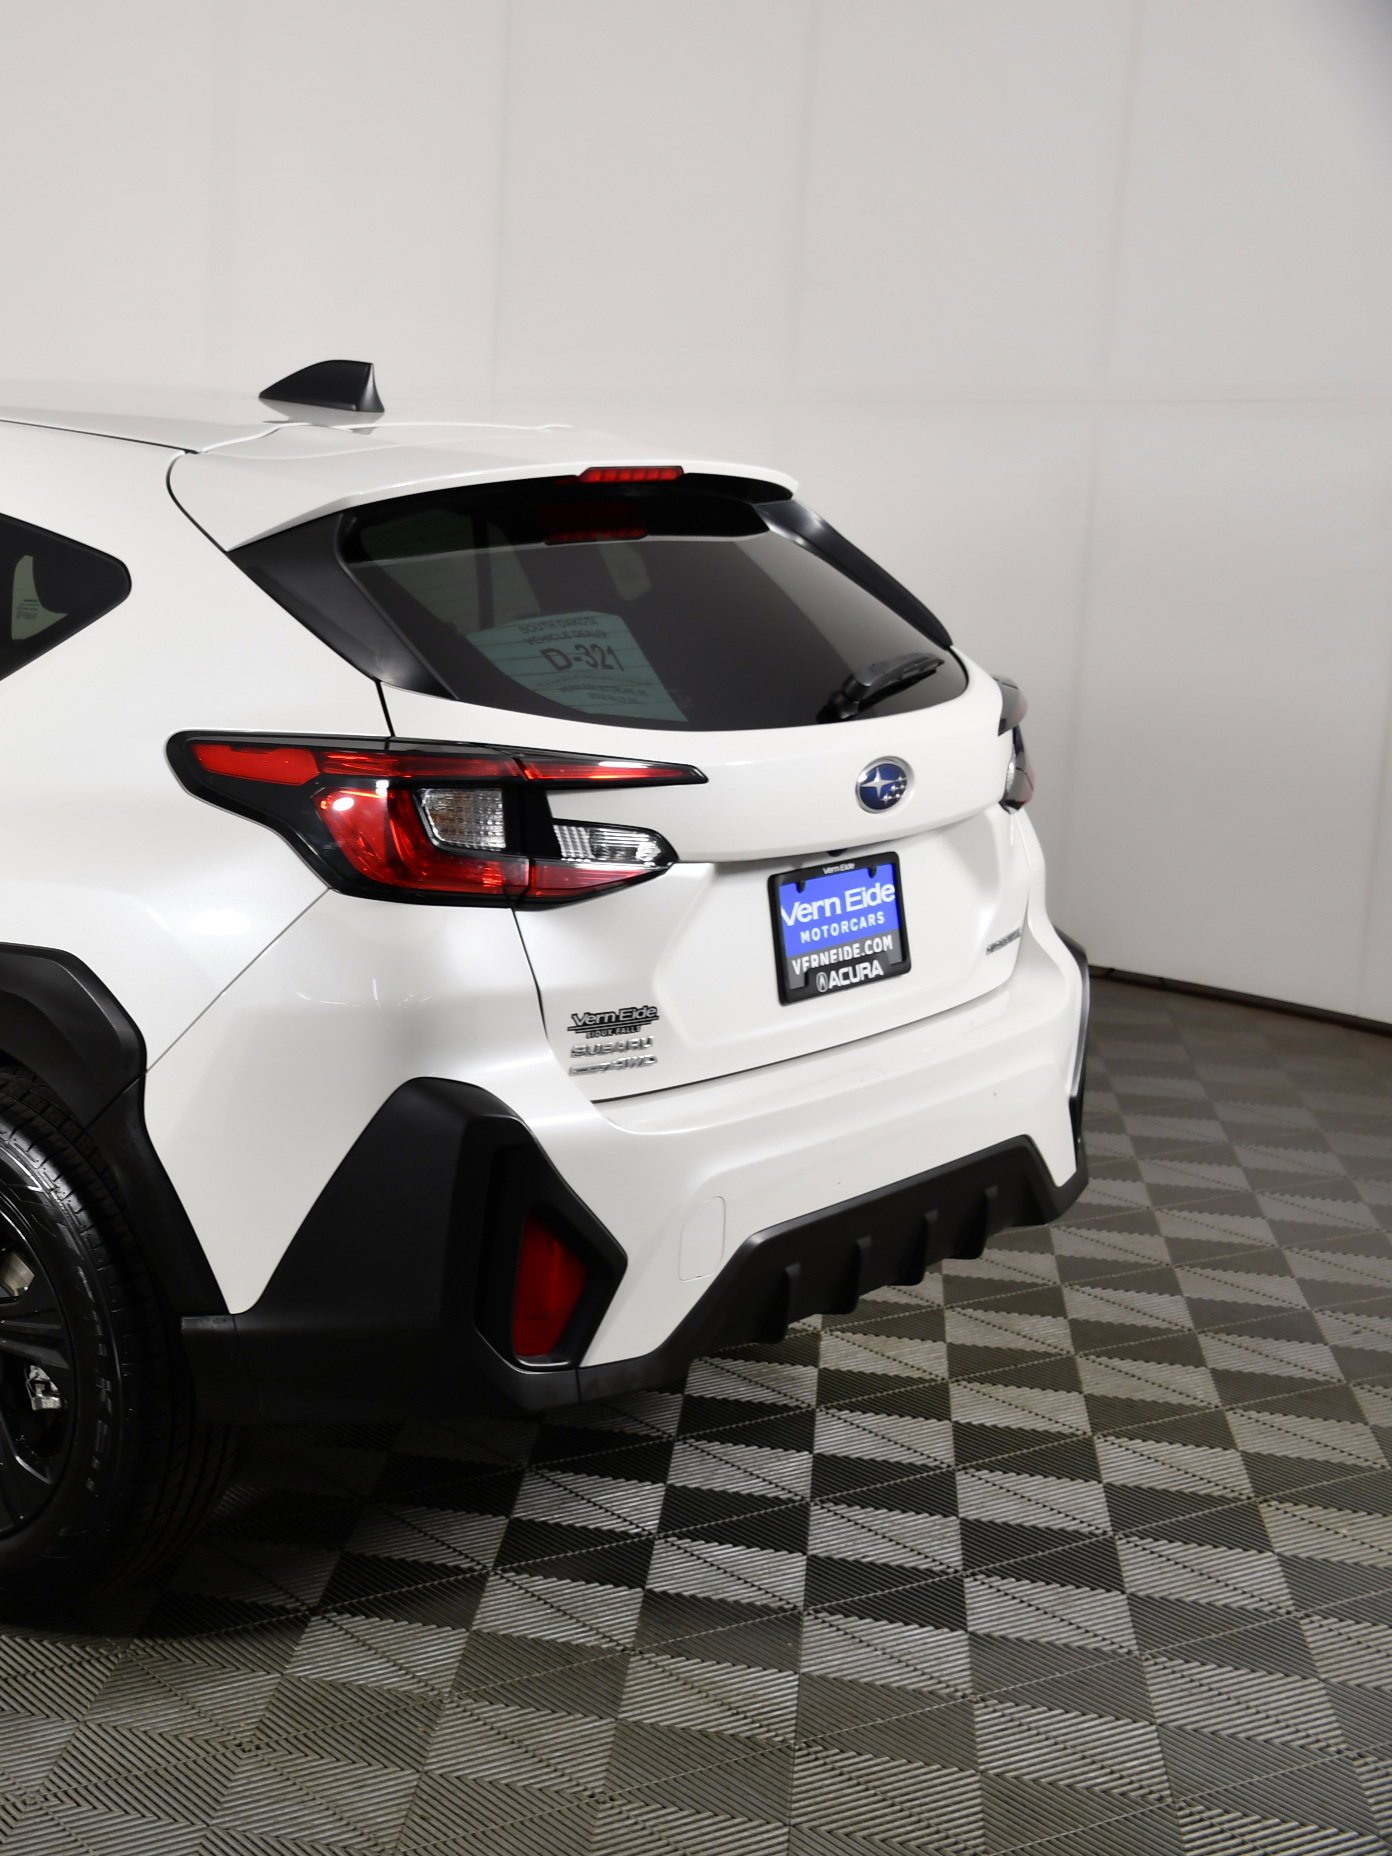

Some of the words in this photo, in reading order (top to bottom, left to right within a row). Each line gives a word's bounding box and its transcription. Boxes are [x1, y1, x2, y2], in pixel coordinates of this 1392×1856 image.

[539, 643, 625, 671] D-321
[823, 866, 839, 875] Vern
[839, 863, 856, 871] Eide
[780, 895, 842, 927] Vern
[844, 882, 896, 913] Eide
[799, 911, 886, 944] MOTORCARS
[791, 934, 894, 976] VERNEIDE.COM
[828, 959, 884, 990] ACURA
[571, 1010, 616, 1027] Vern
[618, 1005, 658, 1020] Eide
[585, 1028, 613, 1039] SIOUX
[615, 1025, 642, 1036] FALLS
[570, 1036, 655, 1058] SUBARU
